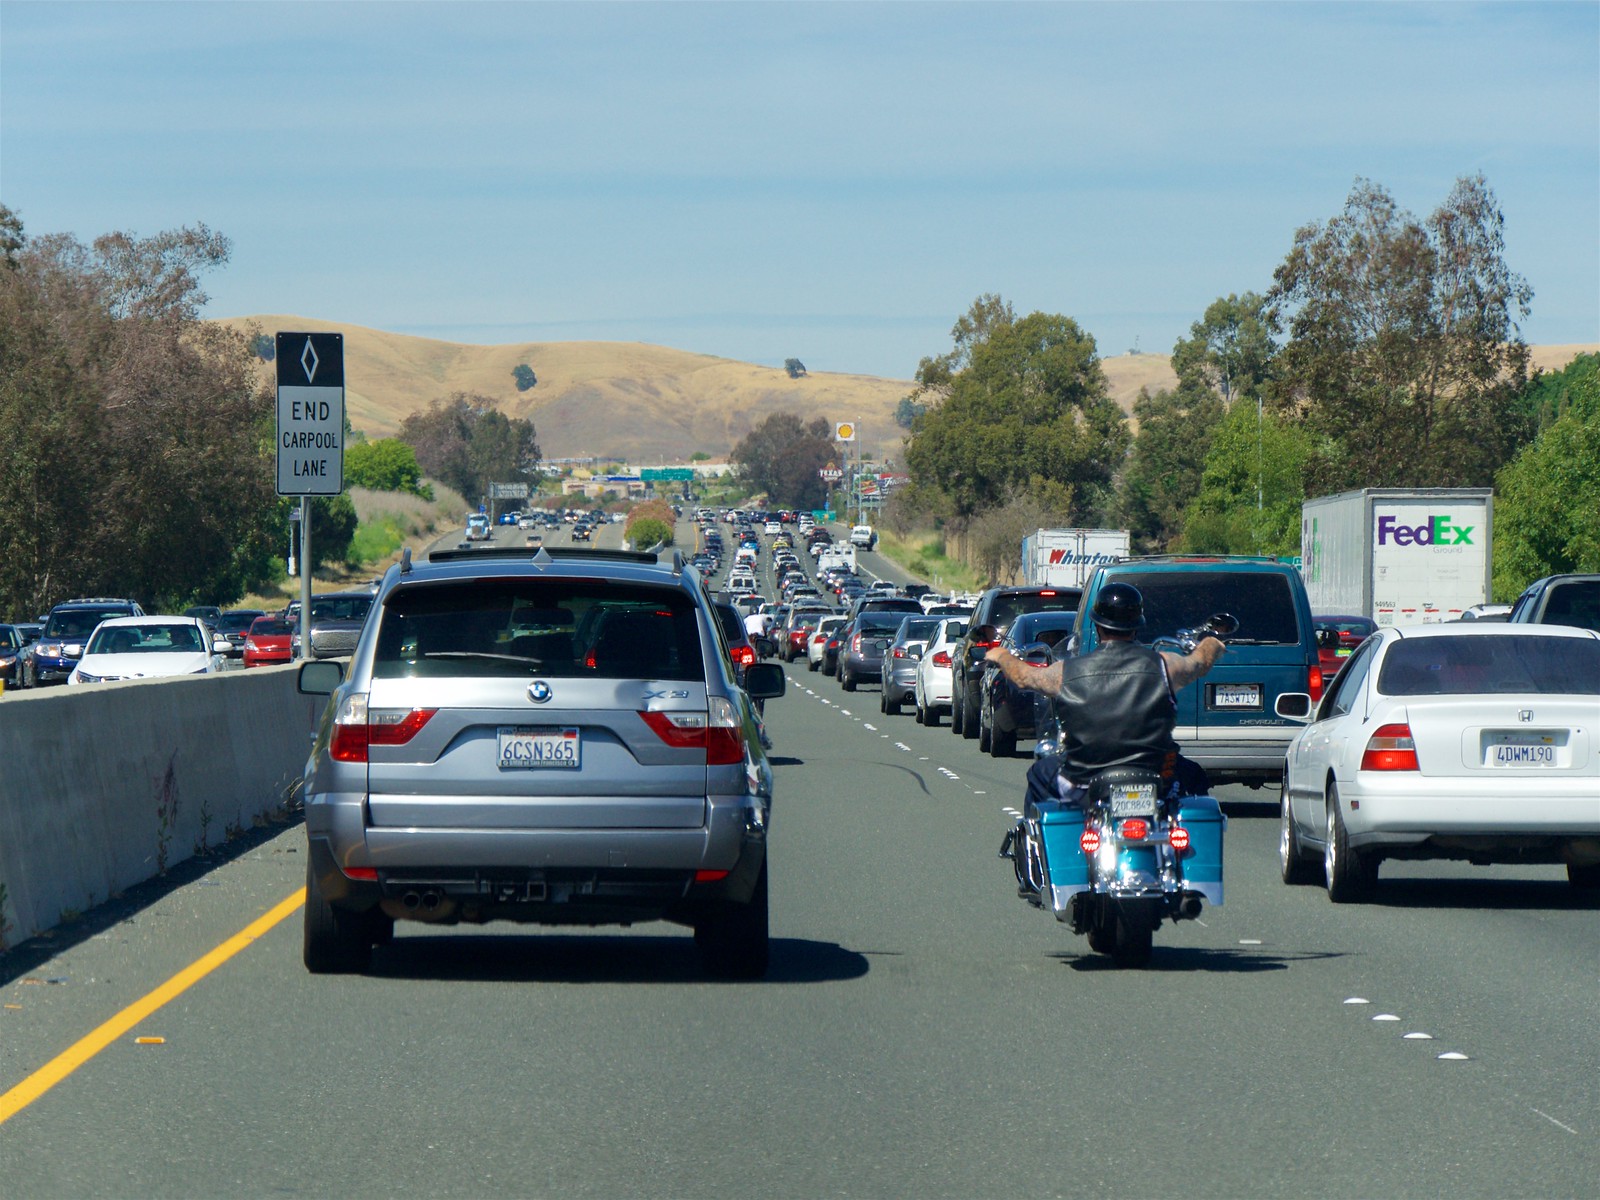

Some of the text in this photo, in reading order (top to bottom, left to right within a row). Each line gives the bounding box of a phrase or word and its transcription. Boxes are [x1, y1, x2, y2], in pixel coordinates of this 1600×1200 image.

[292, 402, 330, 421] END
[283, 432, 338, 449] CARPOOL
[294, 460, 327, 477] LANE
[819, 469, 843, 477] TEXAS
[1378, 515, 1475, 546] FedEx
[1433, 546, 1463, 554] Ground
[1219, 692, 1257, 704] 7ASW719
[503, 740, 574, 760] 6CSN365
[1497, 746, 1553, 762] 4DWM190
[1120, 784, 1152, 792] VALLEJO
